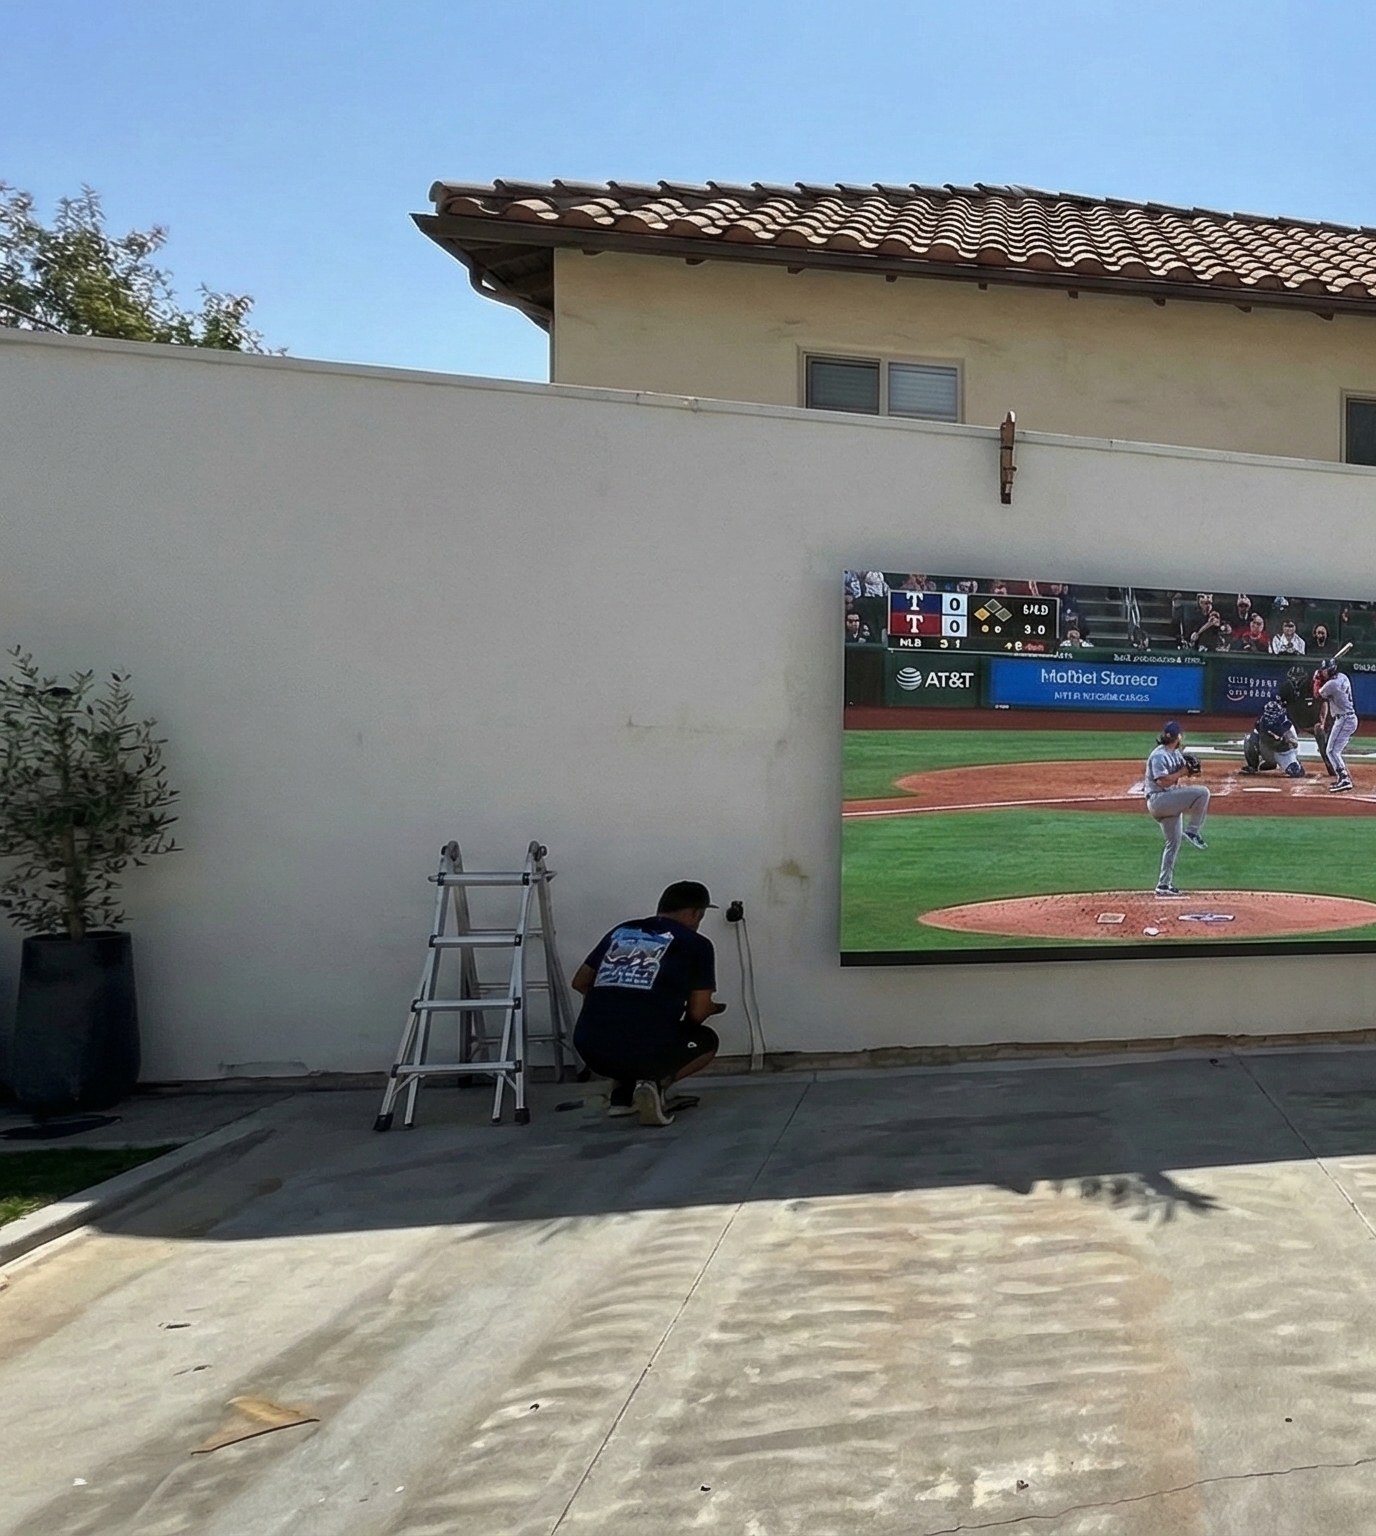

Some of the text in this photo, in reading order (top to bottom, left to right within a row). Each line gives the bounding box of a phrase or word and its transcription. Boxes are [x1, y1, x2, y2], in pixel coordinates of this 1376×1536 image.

[906, 592, 961, 612] T 0
[906, 614, 961, 634] T 0
[925, 671, 974, 689] AT&T
